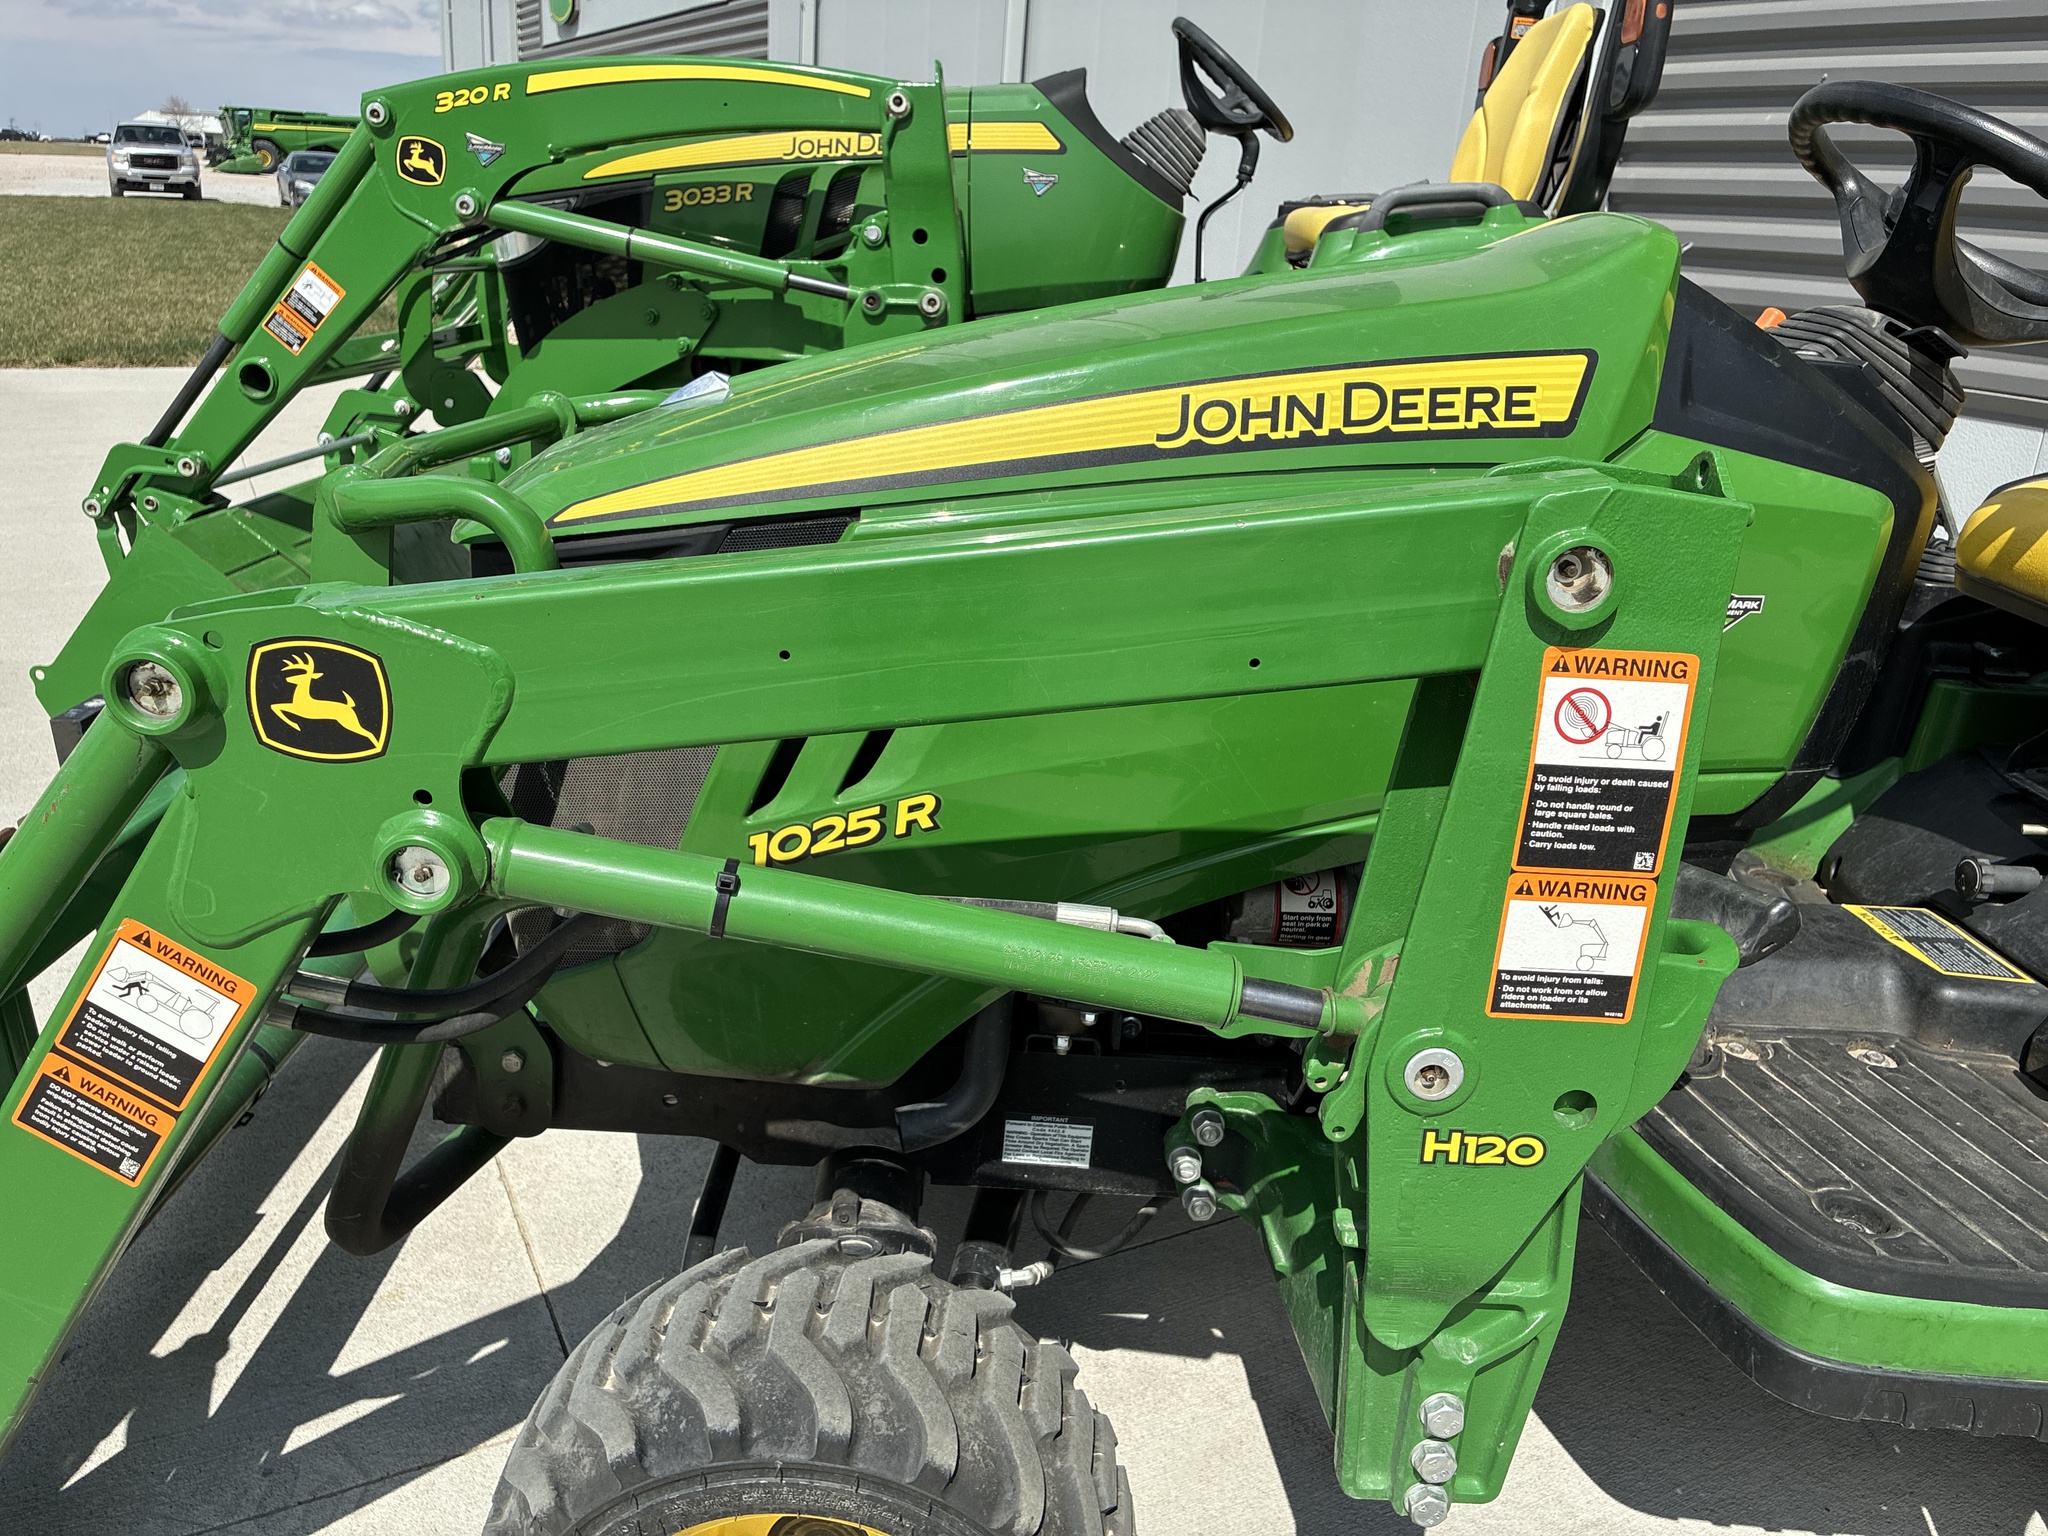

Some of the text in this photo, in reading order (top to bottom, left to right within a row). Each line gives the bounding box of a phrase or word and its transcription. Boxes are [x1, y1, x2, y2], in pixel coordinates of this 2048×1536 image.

[434, 82, 511, 113] 320 R
[783, 137, 851, 156] JOHN
[664, 183, 753, 212] 3033 R
[1155, 381, 1539, 444] JOHN DEERE
[1575, 655, 1688, 679] WARNING
[1534, 783, 1601, 794] by falling loads:
[1536, 774, 1547, 782] To
[1548, 776, 1573, 785] avoid
[1574, 776, 1599, 787] injury
[1612, 778, 1636, 786] death
[1534, 809, 1556, 818] large
[1589, 812, 1614, 820] bales.
[1536, 800, 1548, 808] Do
[1566, 802, 1595, 810] handle
[749, 793, 940, 867] 1025 R
[1531, 830, 1564, 838] caution.
[1532, 821, 1562, 829] Handle
[1564, 823, 1590, 831] raised
[1592, 824, 1615, 832] loads
[1529, 840, 1552, 850] Carry
[1538, 880, 1647, 901] WARNING
[1316, 915, 1332, 923] from
[156, 941, 238, 994] WARNING
[1003, 960, 1109, 987] MADE IN MEXICO
[1537, 975, 1561, 984] injury
[1584, 977, 1604, 985] falls:
[1554, 987, 1573, 995] from
[1500, 1001, 1552, 1010] attachments.
[84, 1013, 109, 1030] loader:
[89, 1007, 177, 1059] To avoid injury from falling
[76, 1042, 102, 1058] parked.
[84, 1030, 109, 1045] service
[110, 1044, 130, 1056] under
[136, 1058, 159, 1072] raised
[159, 1069, 181, 1085] loader.
[86, 1022, 97, 1031] Do
[98, 1029, 110, 1038] not
[111, 1036, 127, 1047] walk
[136, 1050, 164, 1067] perform
[80, 1034, 102, 1049] Lower
[102, 1046, 125, 1061] loader
[133, 1065, 159, 1080] ground
[159, 1078, 177, 1090] when
[46, 1090, 130, 1137] engaging attachment latch.
[49, 1083, 147, 1138] DO NOT operate loader without
[80, 1077, 158, 1127] WARNING
[38, 1104, 56, 1116] result
[64, 1118, 100, 1140] attachment
[100, 1138, 131, 1157] detaching
[41, 1097, 62, 1112] Failure
[71, 1115, 95, 1129] engage
[95, 1128, 120, 1142] retainer
[120, 1141, 139, 1153] could
[1031, 1115, 1069, 1123] IMPORTANT
[31, 1115, 51, 1128] bodily
[51, 1125, 70, 1138] injury
[78, 1141, 97, 1153] death.
[35, 1109, 120, 1158] from loader causing serious
[1421, 1129, 1546, 1167] H120
